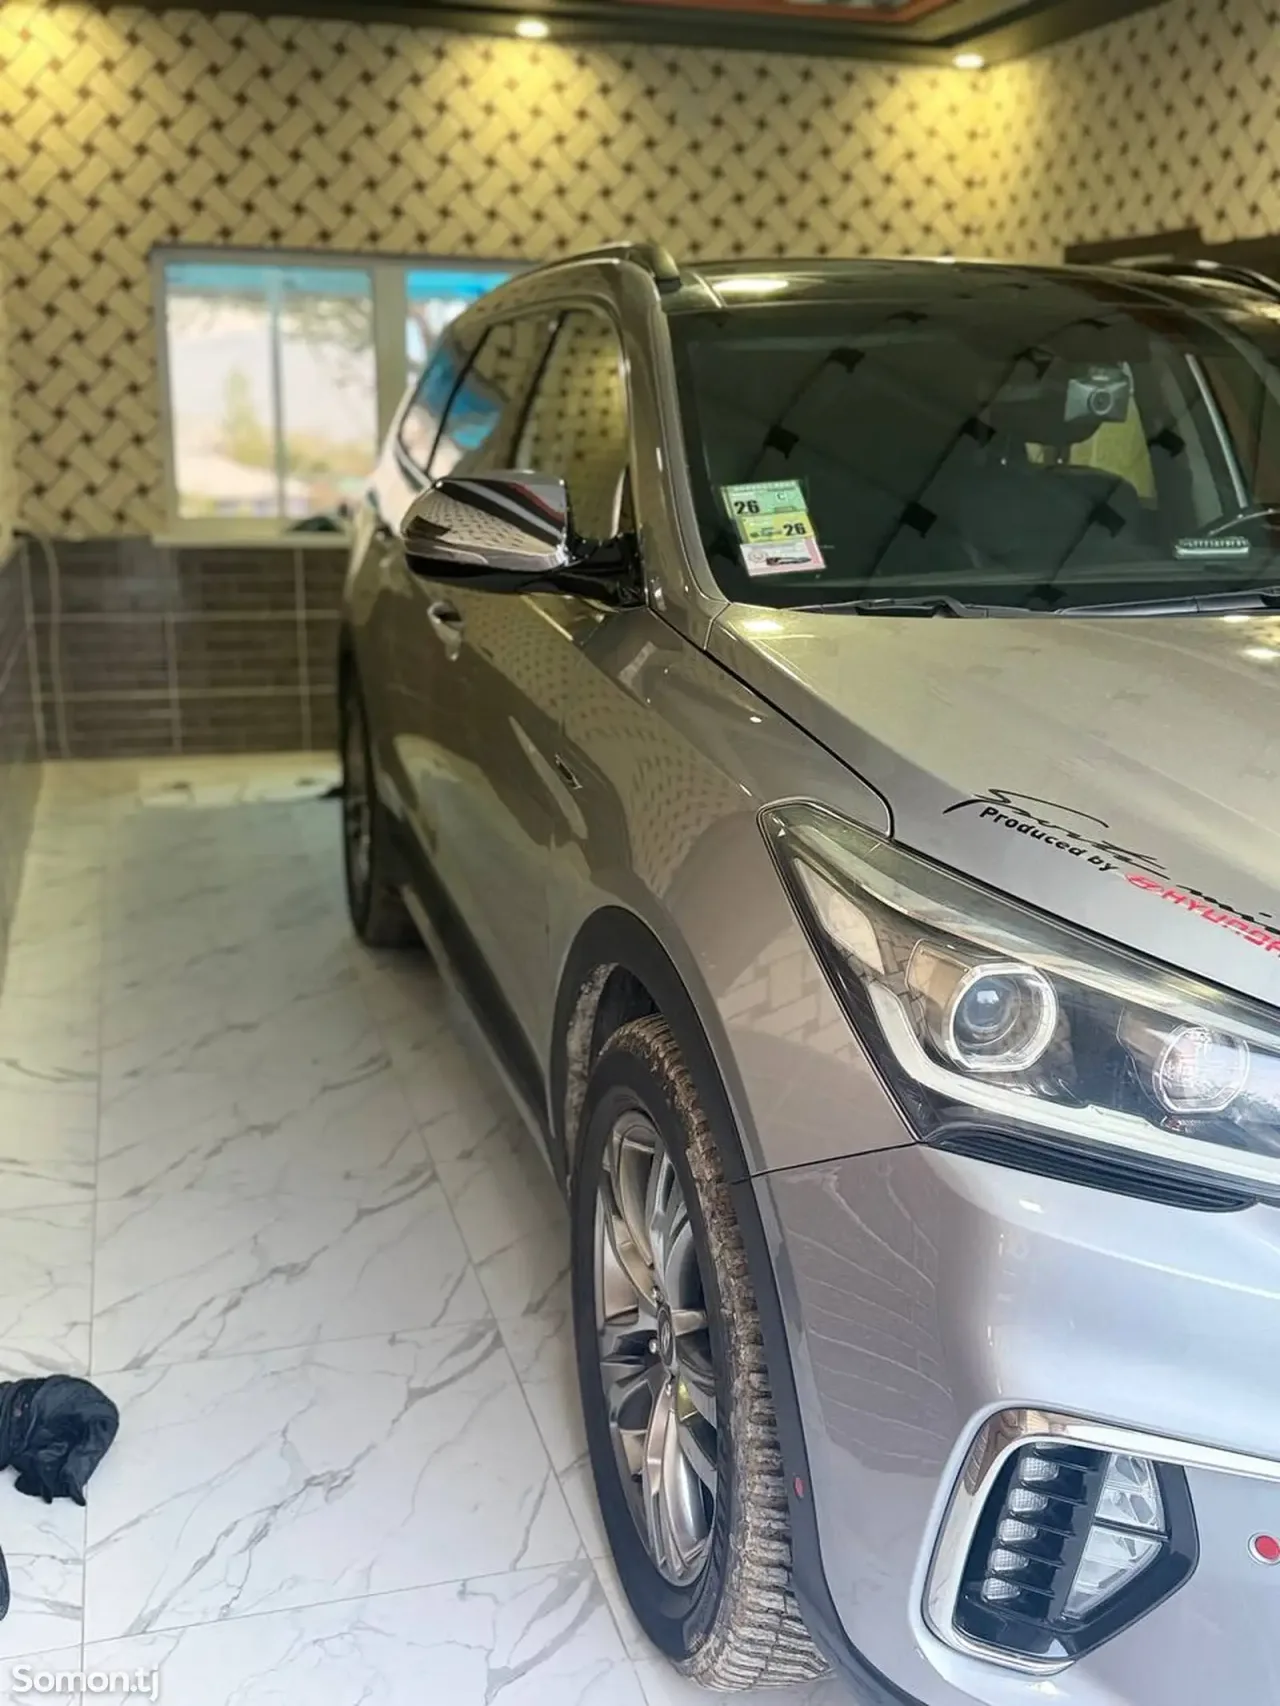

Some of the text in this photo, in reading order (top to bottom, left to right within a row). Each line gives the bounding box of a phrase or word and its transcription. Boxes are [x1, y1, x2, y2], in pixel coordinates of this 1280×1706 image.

[733, 499, 760, 515] 26
[783, 522, 806, 537] 26
[979, 805, 1280, 957] Produced by HYUNDA
